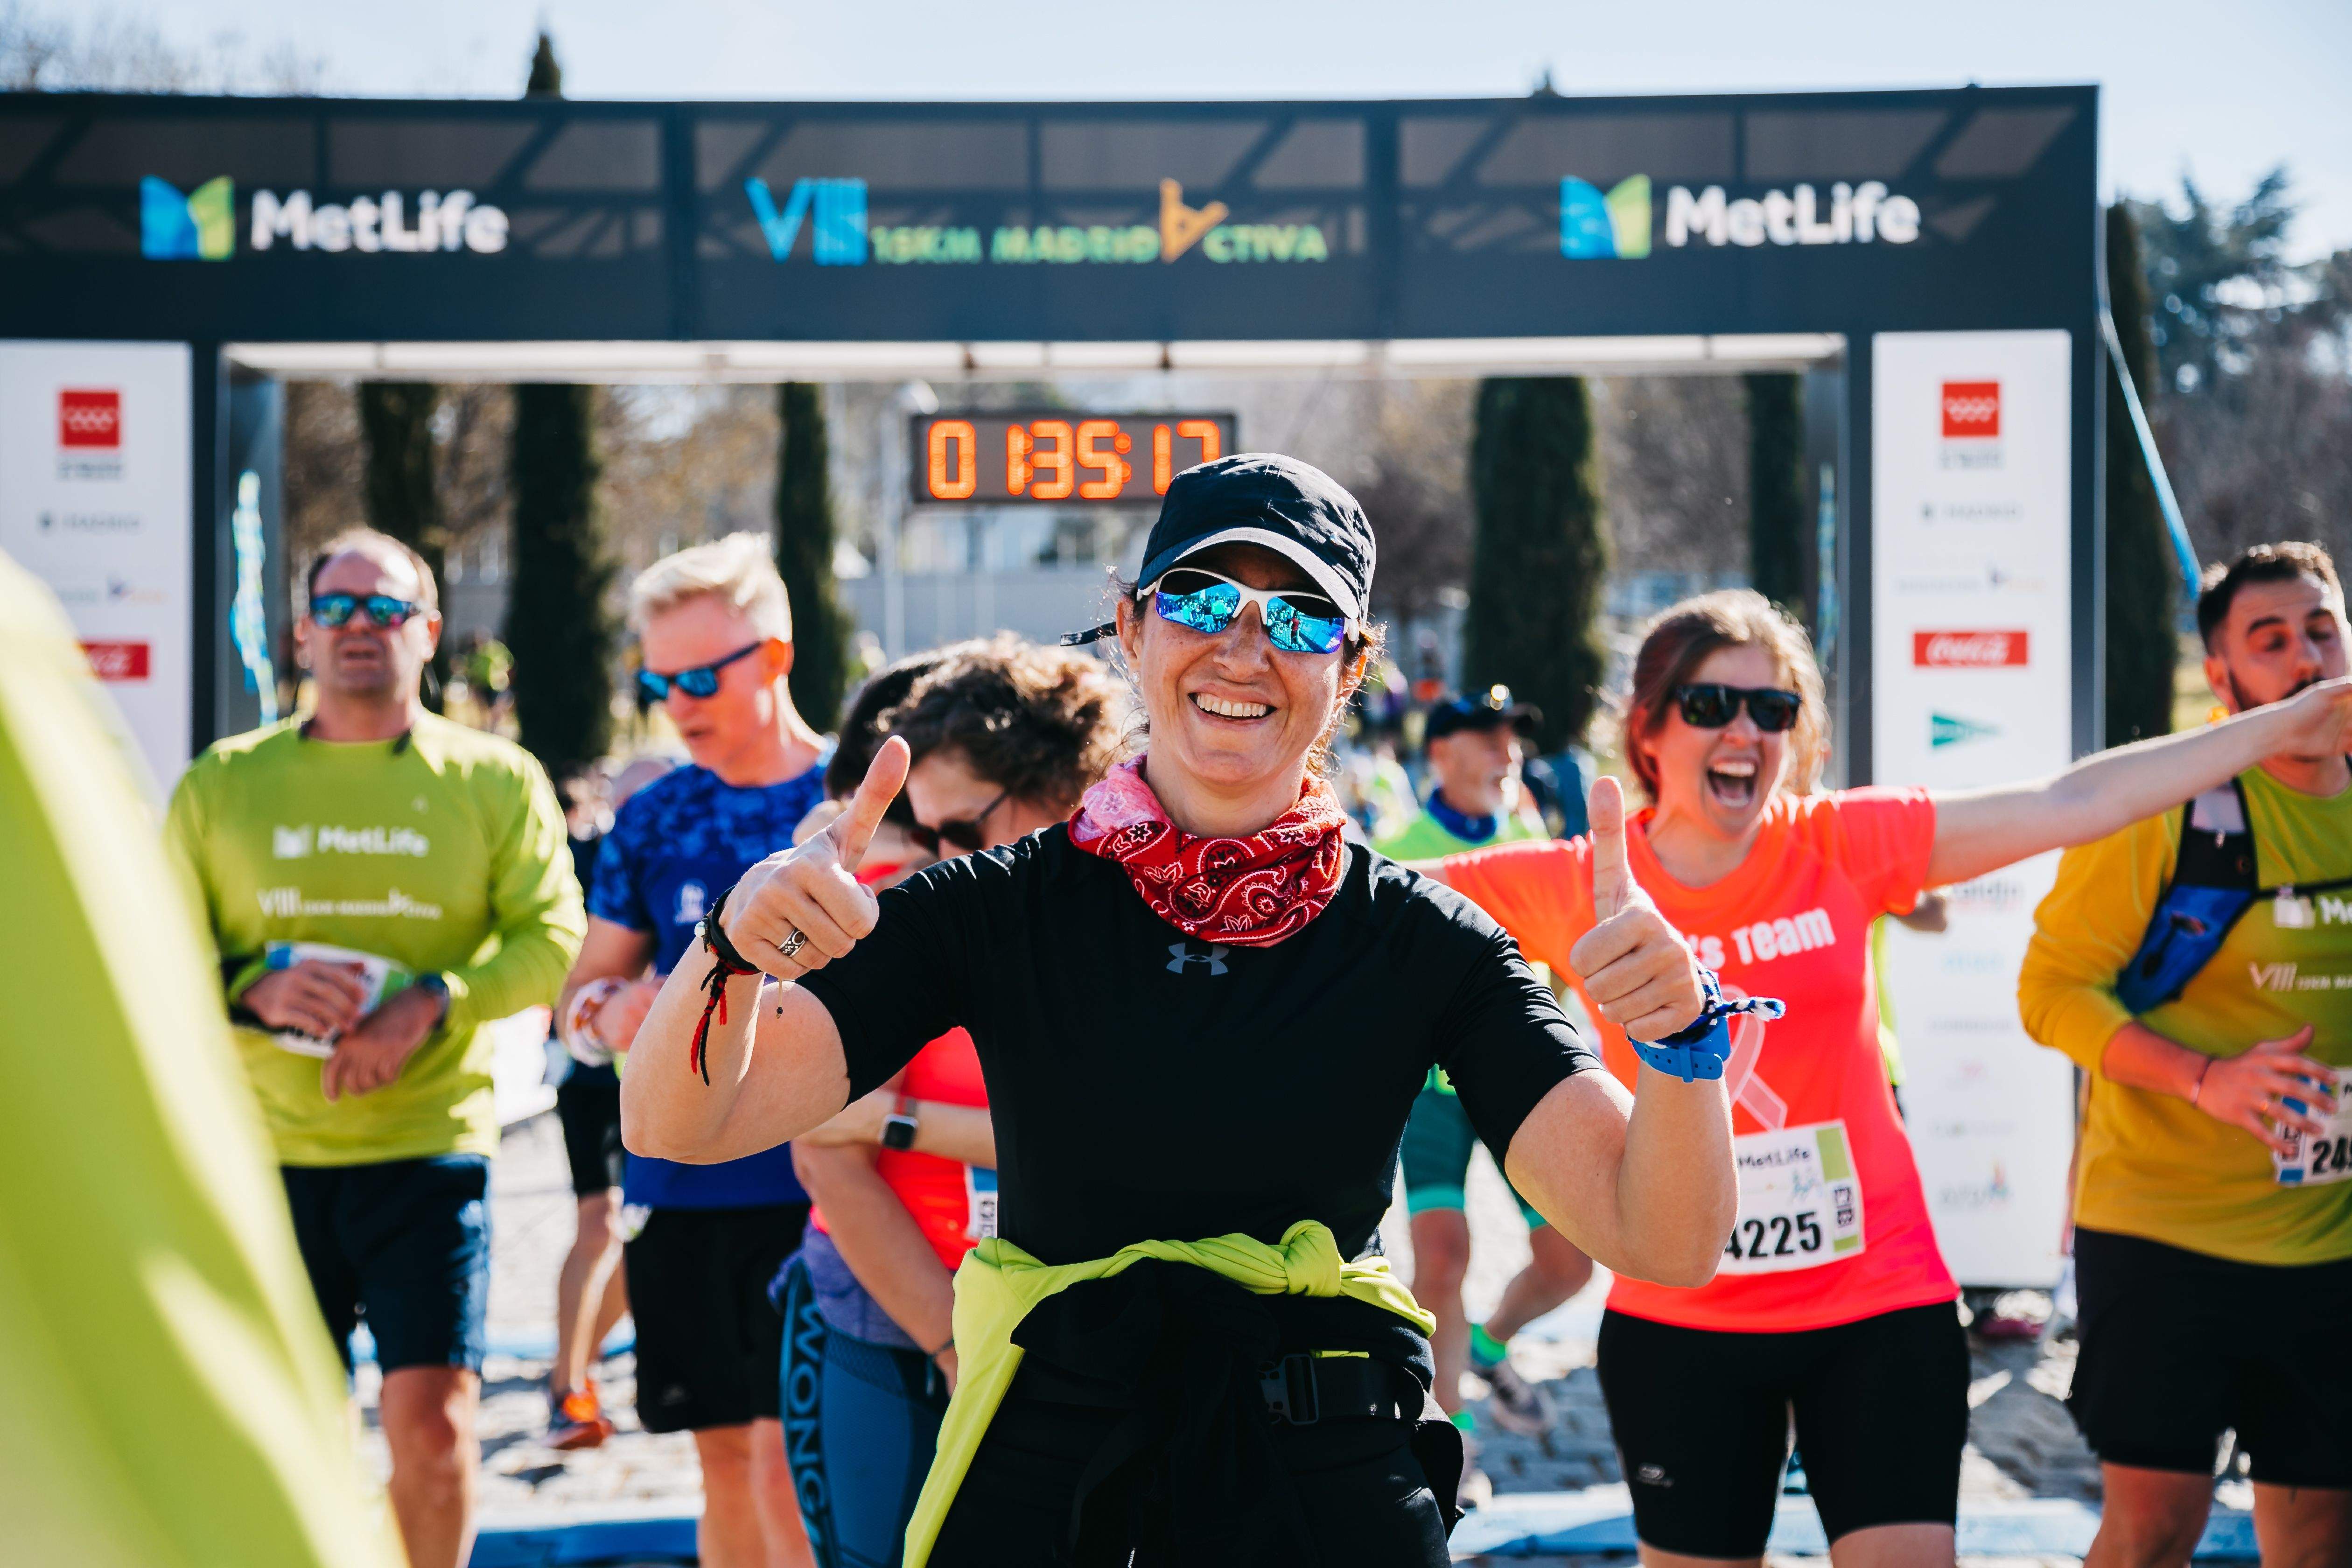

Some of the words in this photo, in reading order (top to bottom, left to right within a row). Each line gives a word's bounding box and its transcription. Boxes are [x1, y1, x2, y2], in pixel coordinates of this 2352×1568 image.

[250, 189, 510, 253] MetLife
[1666, 180, 1921, 247] MetLife
[989, 225, 1162, 265] MADRID
[317, 825, 430, 857] MetLife
[1730, 907, 1837, 966] Team
[2311, 1135, 2352, 1176] 24
[787, 1302, 828, 1516] WONG
